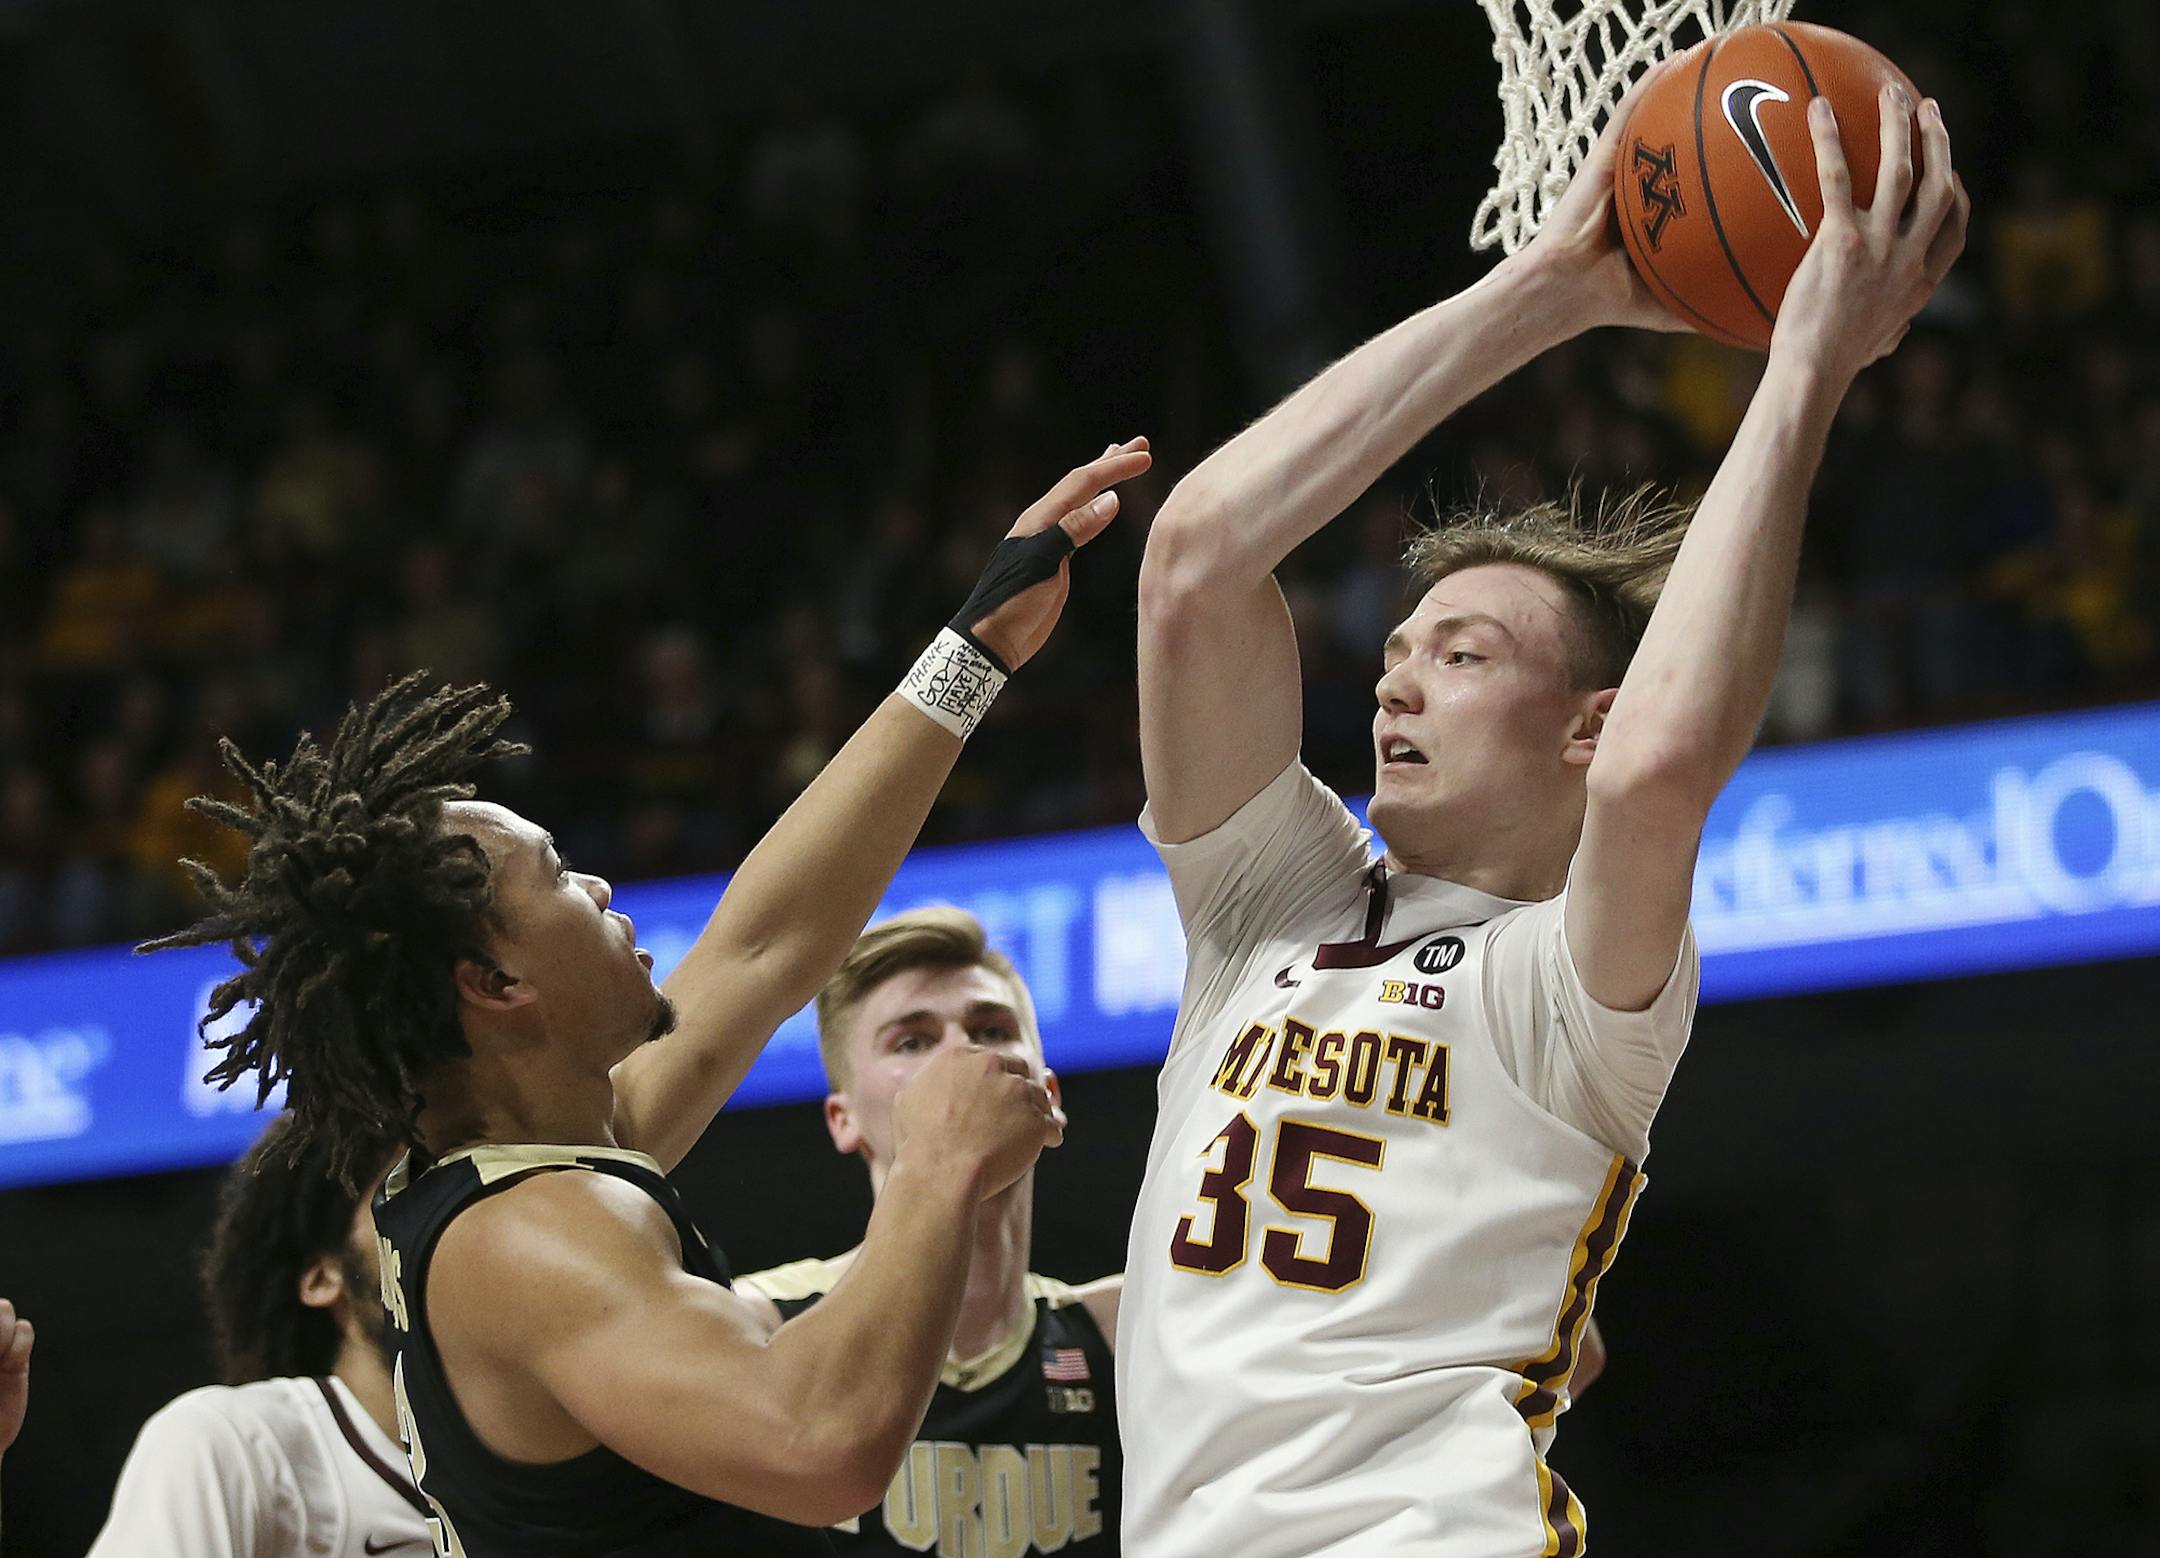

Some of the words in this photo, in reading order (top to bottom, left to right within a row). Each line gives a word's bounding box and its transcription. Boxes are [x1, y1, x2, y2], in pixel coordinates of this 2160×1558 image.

[904, 641, 950, 688] THANK
[917, 664, 952, 706] GOD
[943, 673, 974, 709] HAVE
[1424, 943, 1458, 969] TM
[1169, 1109, 1387, 1295] 35
[834, 1440, 1102, 1558] URDUE
